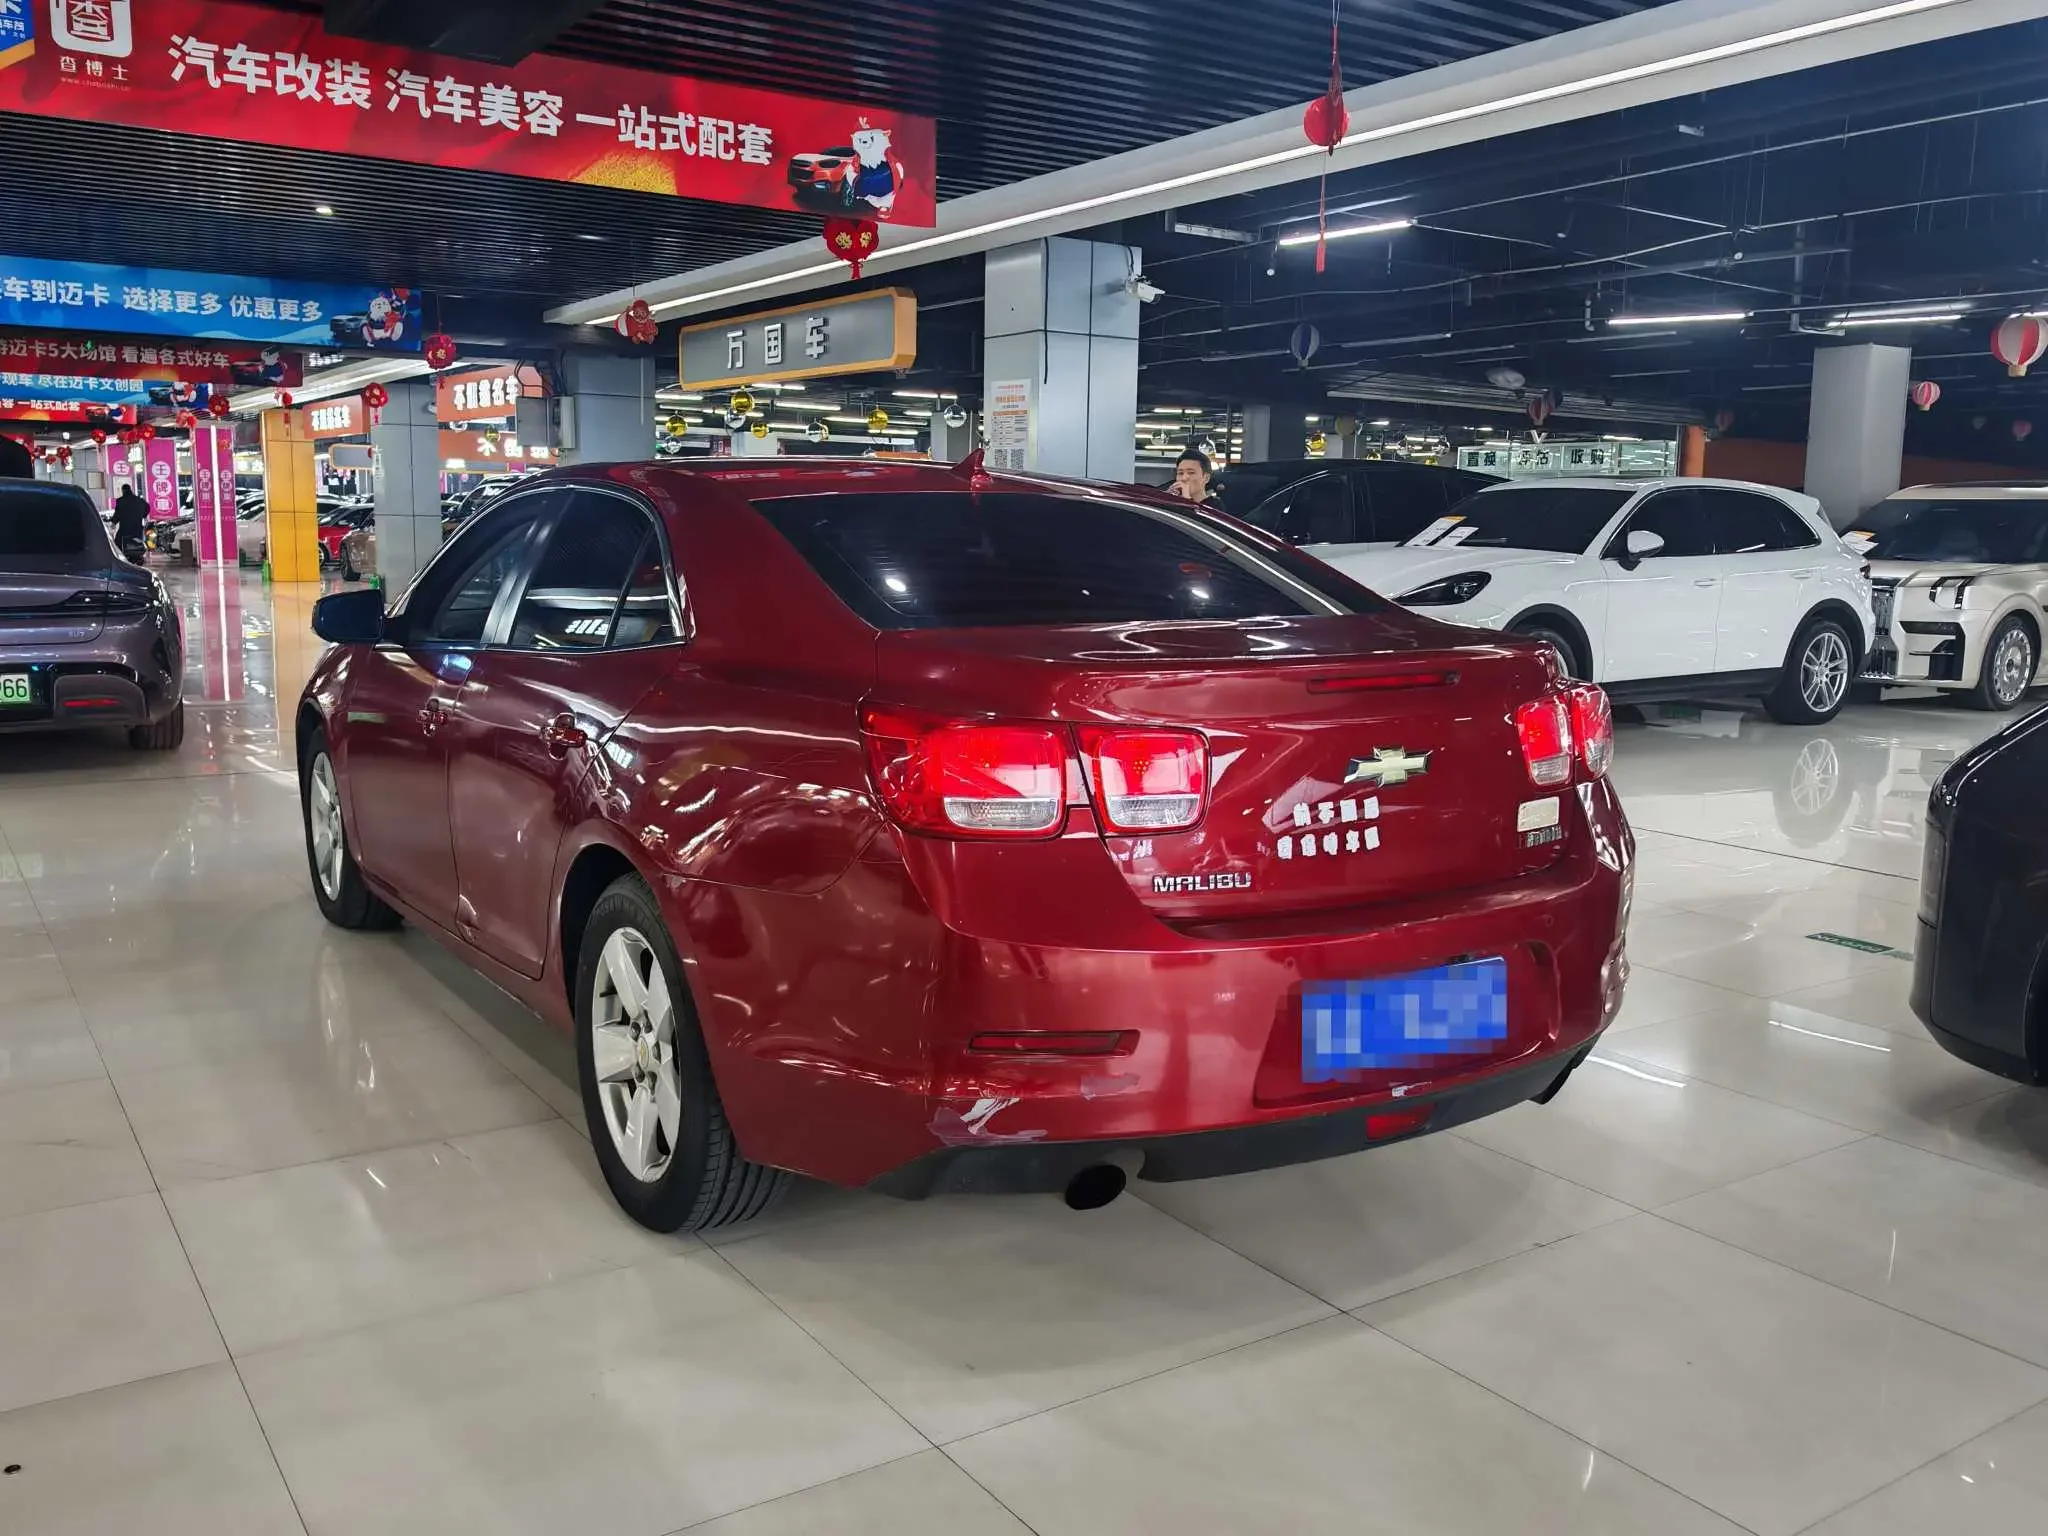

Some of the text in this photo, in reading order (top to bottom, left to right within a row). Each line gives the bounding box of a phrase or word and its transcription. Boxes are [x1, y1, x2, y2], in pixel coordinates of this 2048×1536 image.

[60, 56, 129, 81] 查博士
[167, 33, 774, 166] 汽车改装 汽车美容 一站式配套
[0, 276, 324, 323] 车到迈卡 选择更多 优惠更多
[726, 315, 829, 370] 万国车
[121, 346, 230, 368] 看遍各式好车
[0, 372, 144, 393] 现车 尽在迈卡文创园
[0, 679, 28, 698] 66
[1153, 872, 1252, 893] MALIBU
